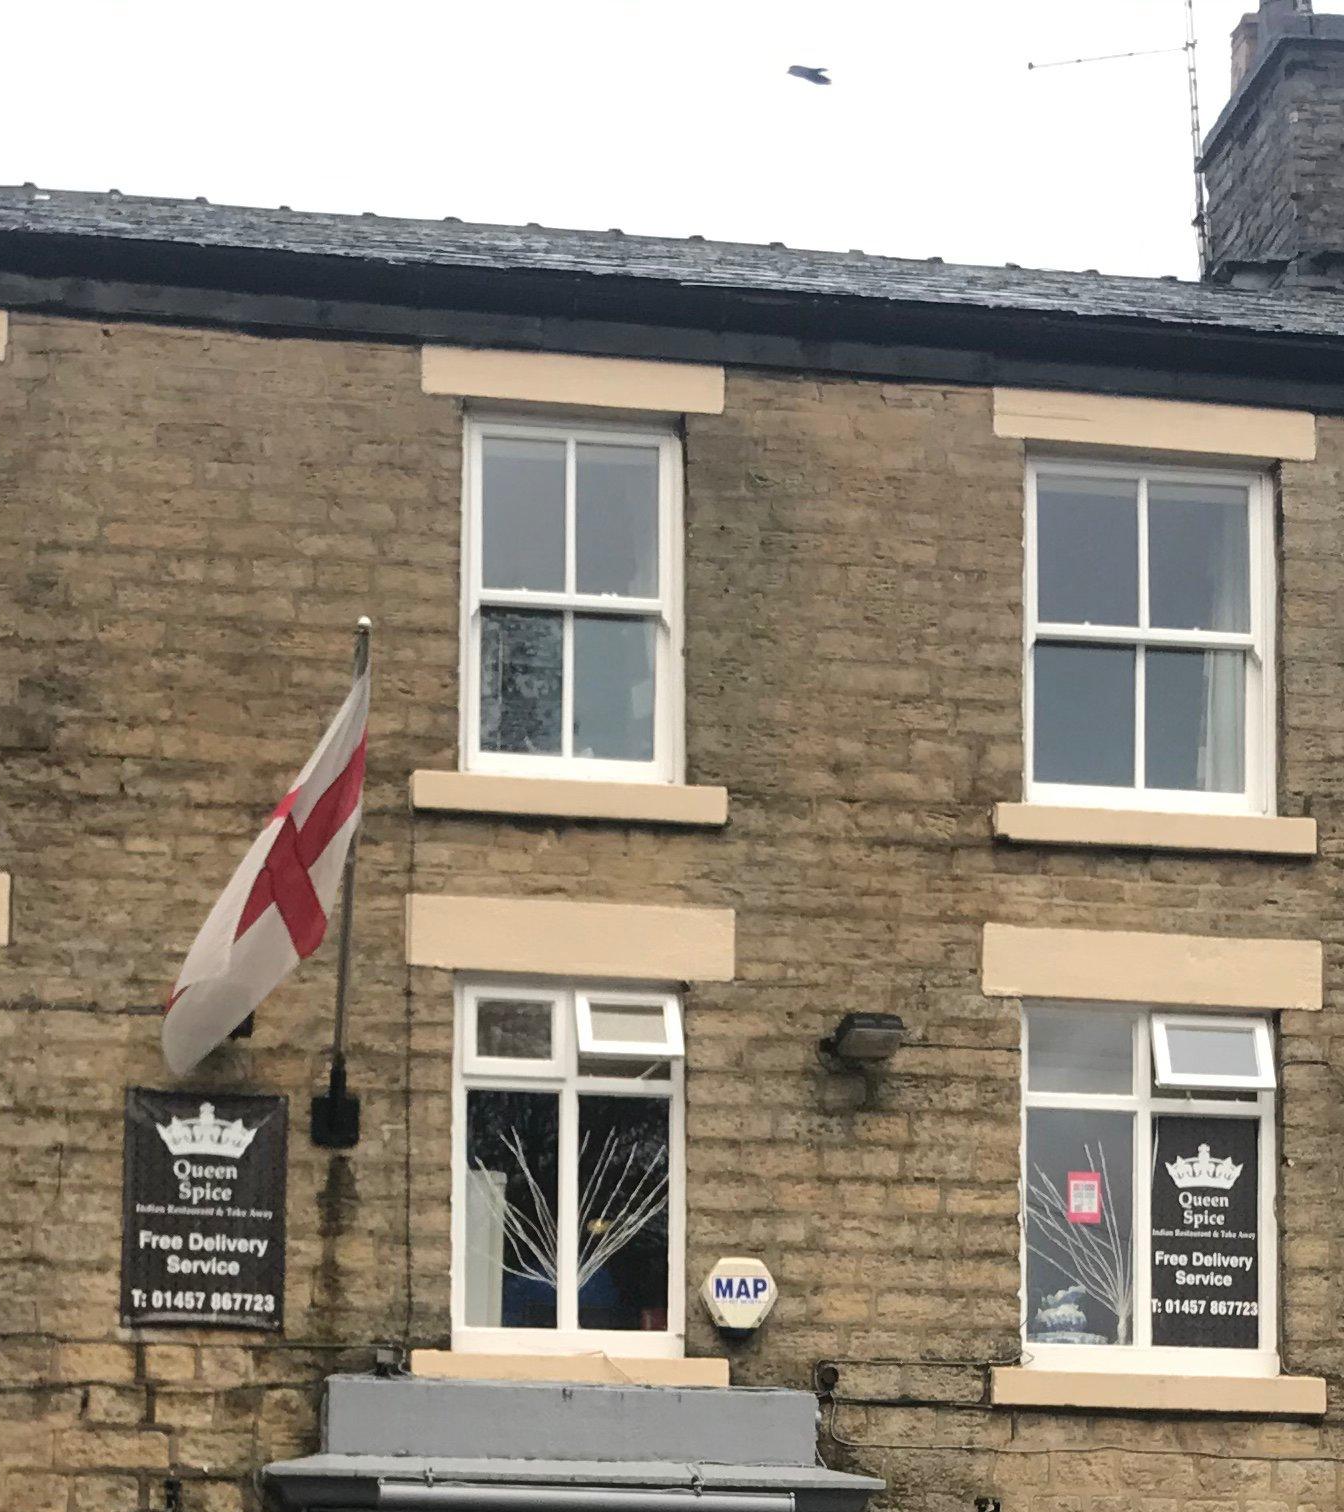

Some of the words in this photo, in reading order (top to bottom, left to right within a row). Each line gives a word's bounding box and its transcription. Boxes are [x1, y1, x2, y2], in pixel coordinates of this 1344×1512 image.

[173, 1159, 238, 1181] Queen
[179, 1180, 232, 1205] Spice
[1178, 1191, 1229, 1209] Queen
[1183, 1209, 1225, 1228] Spice
[139, 1230, 183, 1250] Free
[189, 1232, 268, 1257] Delivery
[166, 1254, 240, 1276] Service
[1155, 1251, 1188, 1266] Free
[1192, 1252, 1253, 1271] Delivery
[715, 1278, 767, 1299] MAP
[1175, 1270, 1233, 1287] Service
[131, 1288, 147, 1308] T:
[152, 1290, 206, 1309] 01457
[210, 1292, 275, 1312] 867723
[1151, 1298, 1162, 1313] T:
[1164, 1299, 1206, 1314] 01457
[1210, 1300, 1258, 1316] 867723
